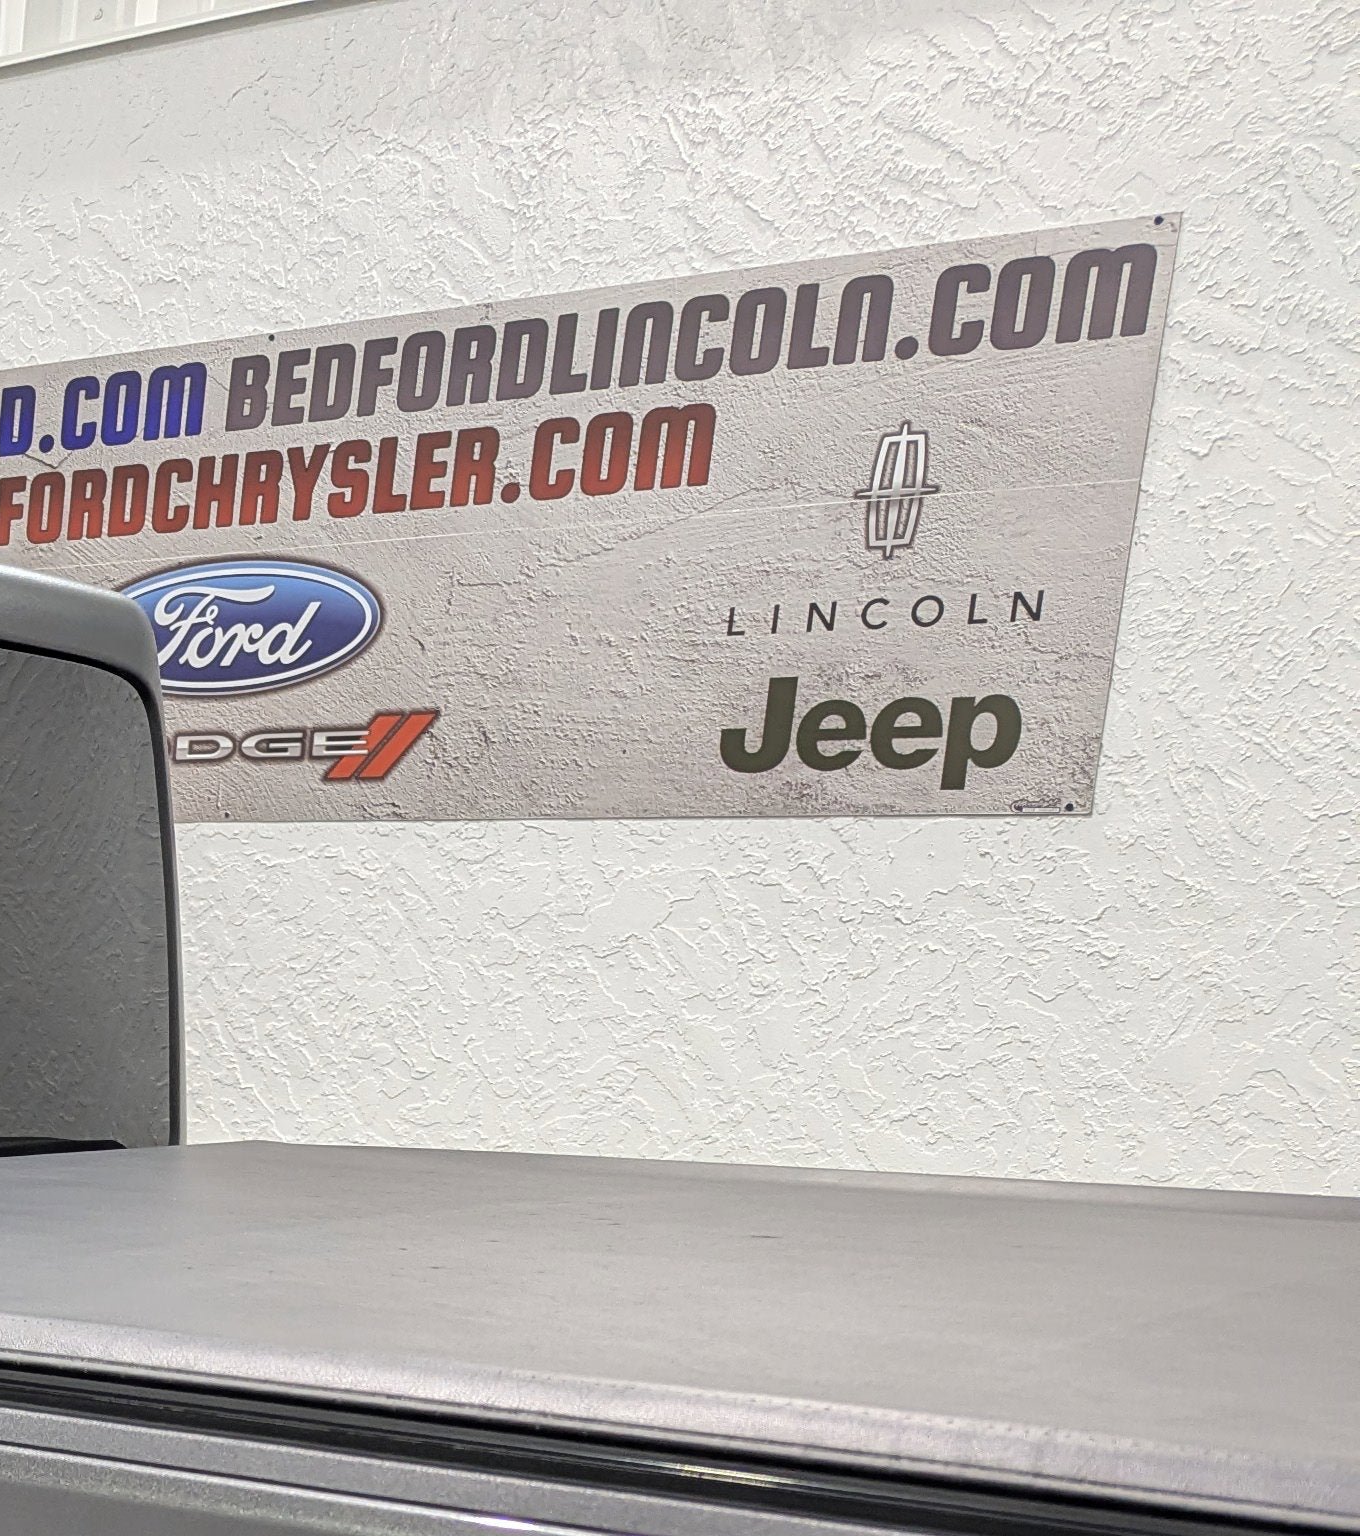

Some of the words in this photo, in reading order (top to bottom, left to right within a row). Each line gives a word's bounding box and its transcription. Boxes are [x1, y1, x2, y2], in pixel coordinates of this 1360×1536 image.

[225, 243, 1158, 432] BEDFORDLINCOLN.COM
[154, 585, 321, 669] Ford
[727, 590, 1044, 637] LINCOLN
[720, 676, 1022, 790] Jeep
